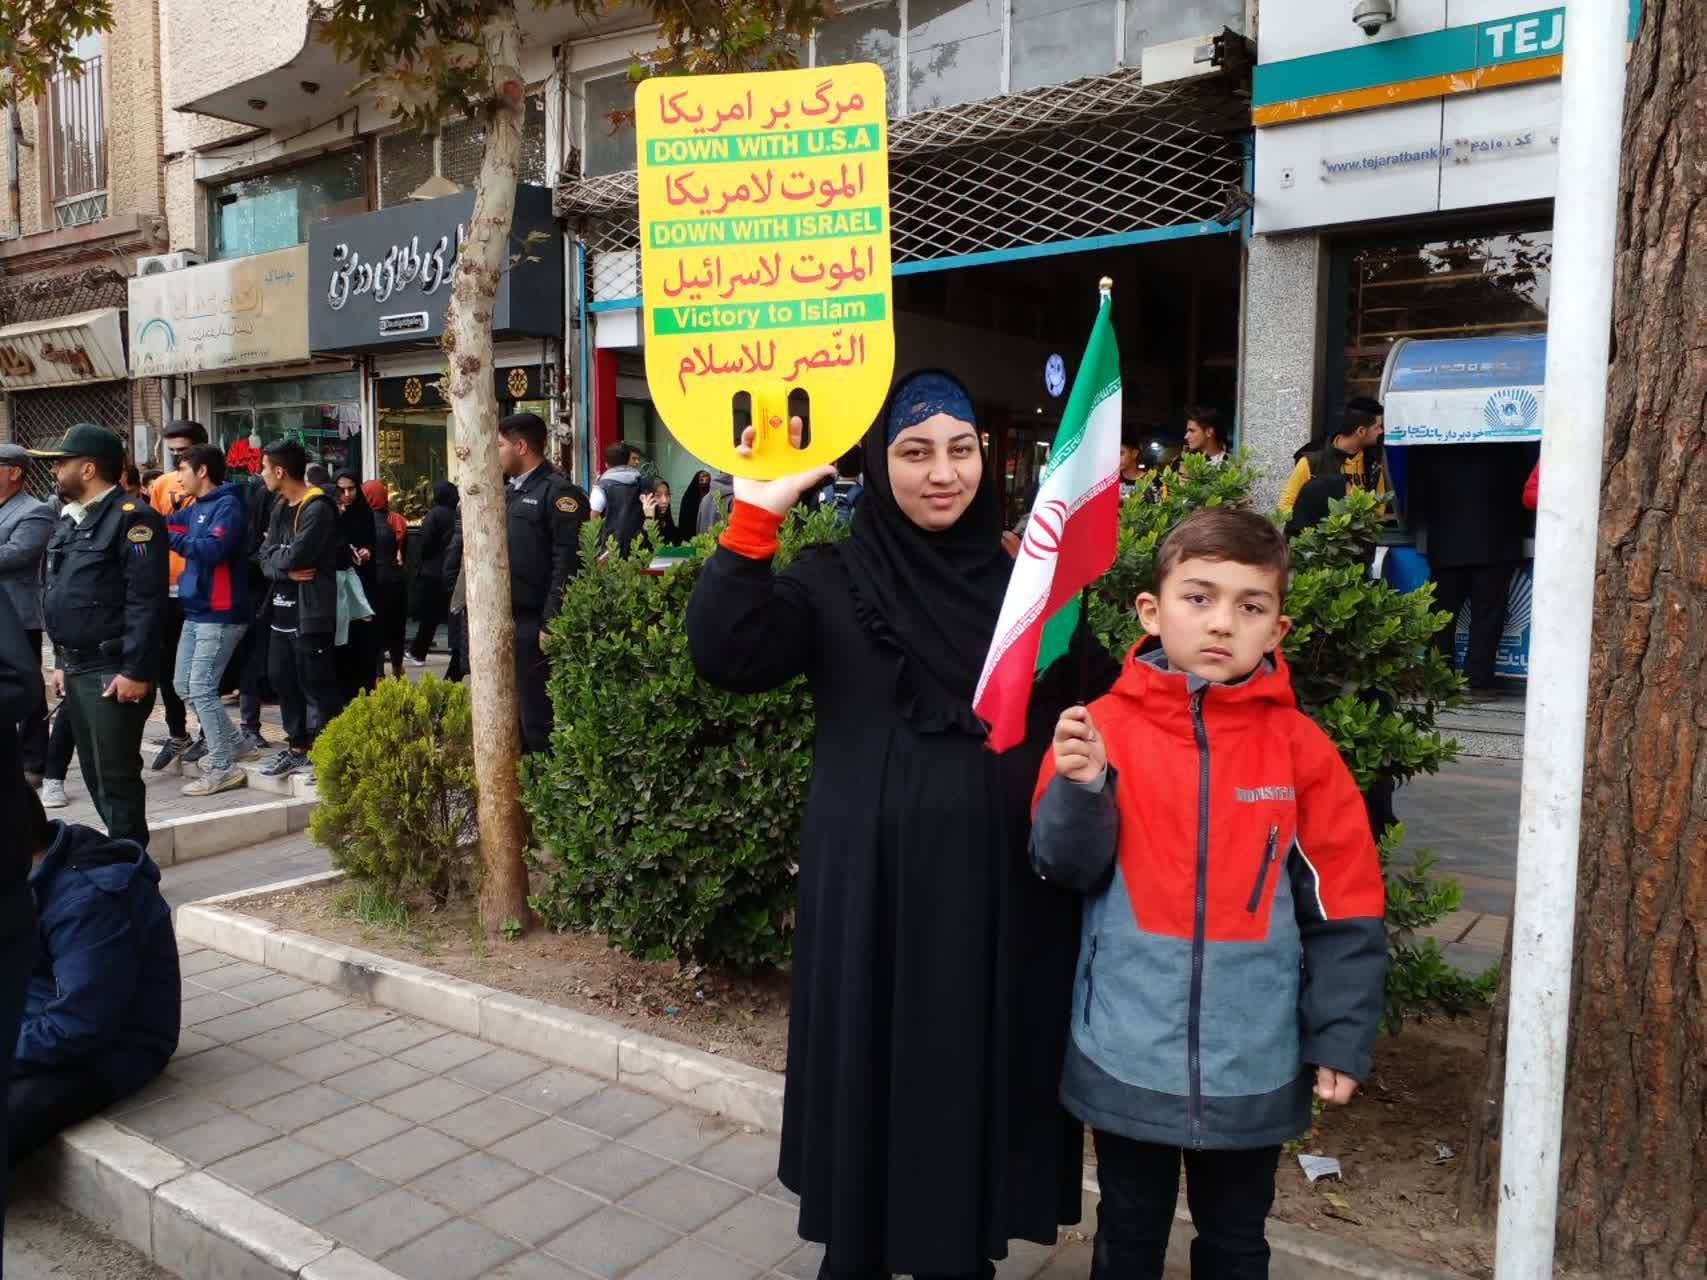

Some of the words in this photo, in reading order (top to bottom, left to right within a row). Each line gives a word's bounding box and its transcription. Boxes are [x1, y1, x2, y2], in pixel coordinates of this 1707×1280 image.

[659, 90, 753, 134] امریکا
[761, 99, 791, 129] بر
[801, 79, 865, 124] مرگ
[654, 138, 728, 162] DOWN
[736, 133, 799, 157] WITH
[807, 127, 871, 152] U.S.A
[665, 168, 773, 215] لامریکا
[781, 162, 865, 208] الموت
[654, 223, 725, 245] DOWN
[732, 217, 788, 240] WITH
[795, 211, 877, 236] ISRAEL
[663, 252, 782, 300] لاسرائیل
[790, 245, 874, 291] الموت
[672, 305, 761, 329] Victory
[767, 303, 793, 323] to
[800, 300, 866, 320] Islam
[678, 339, 776, 396] للاسلام
